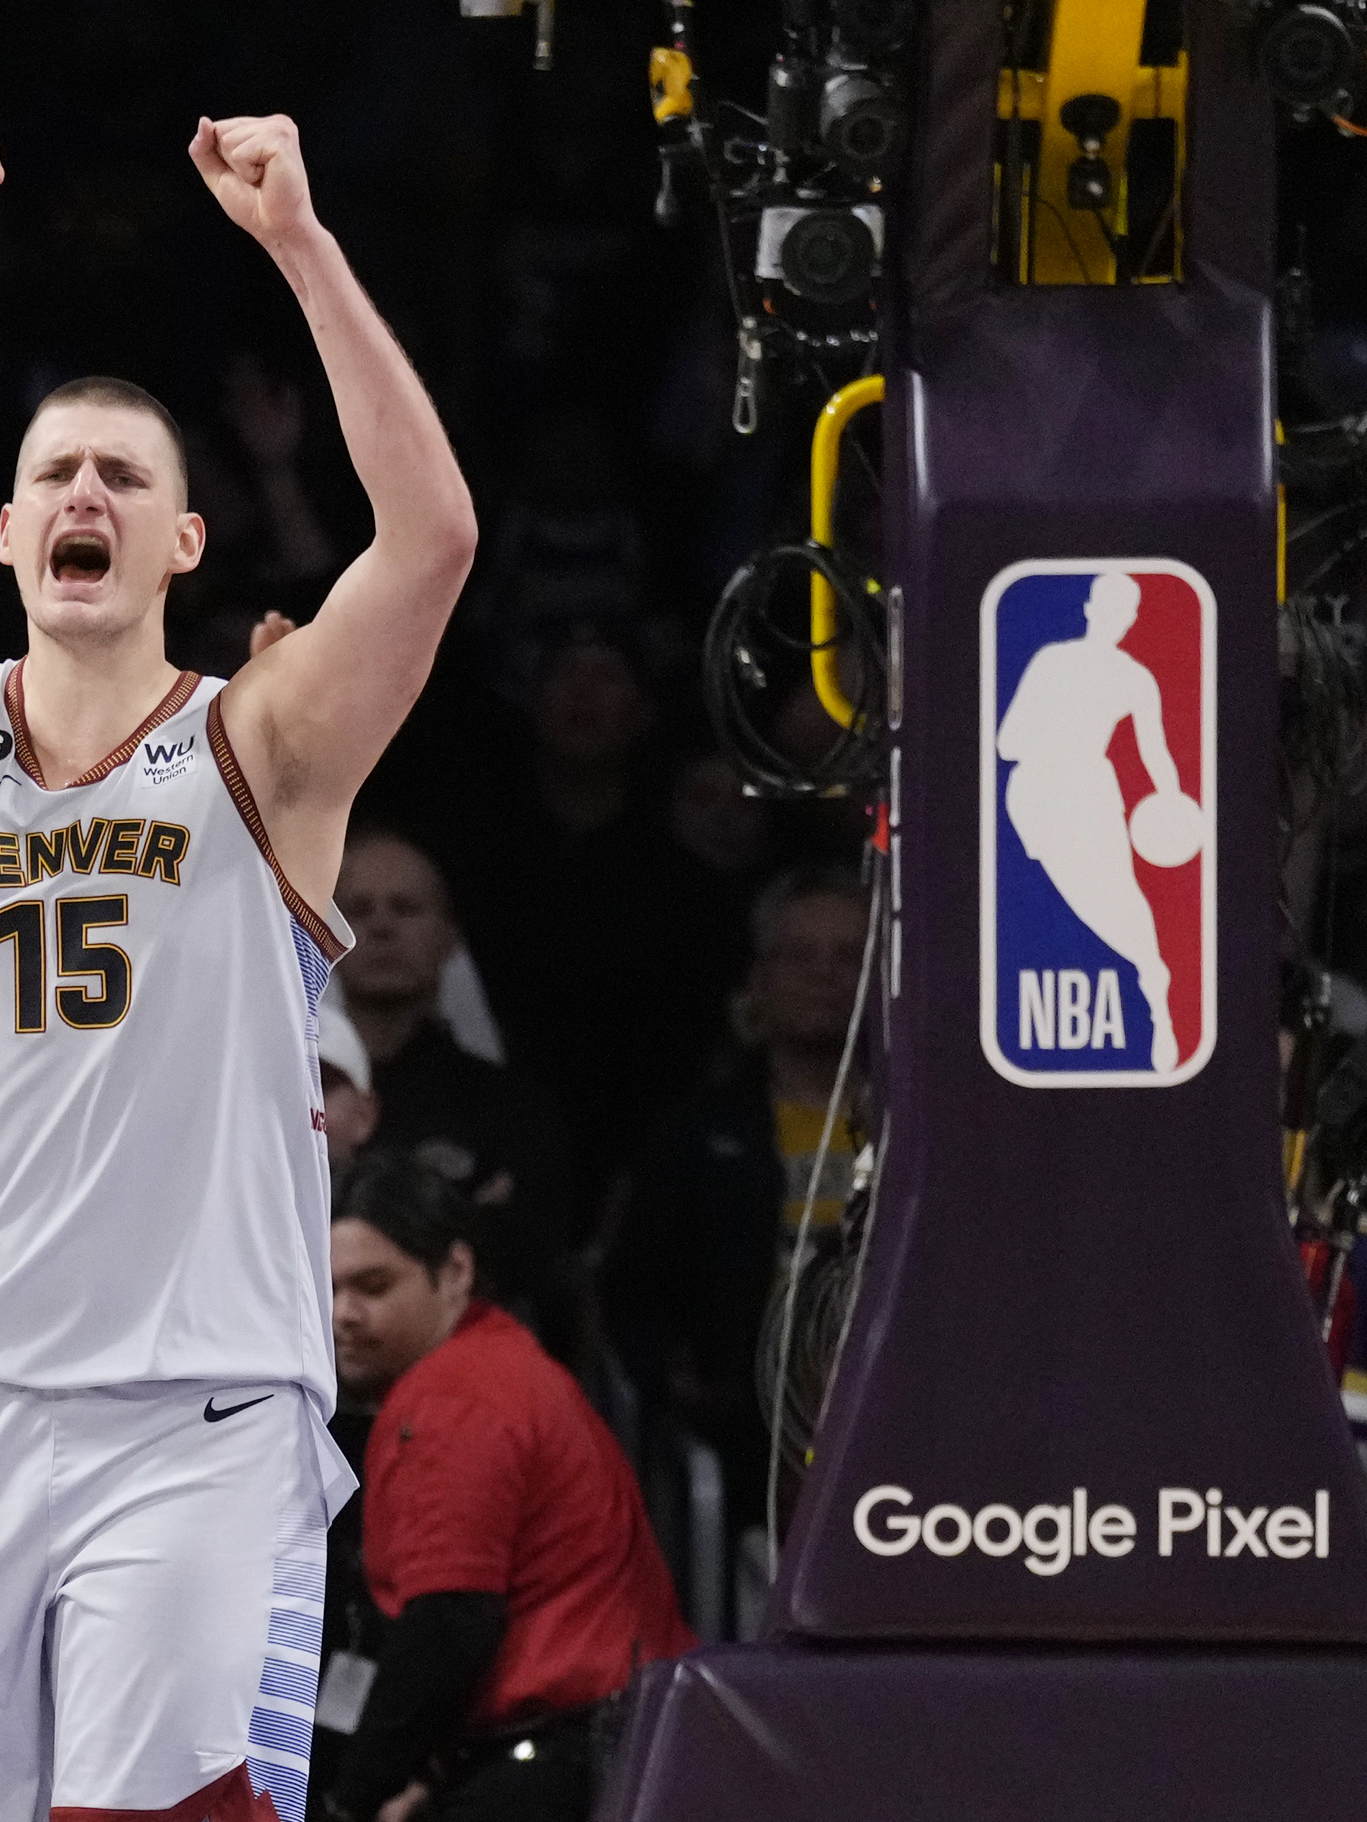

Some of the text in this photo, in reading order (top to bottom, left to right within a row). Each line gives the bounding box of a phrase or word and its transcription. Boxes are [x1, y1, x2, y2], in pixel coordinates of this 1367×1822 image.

[143, 754, 194, 776] Western
[144, 734, 195, 765] WU
[153, 766, 187, 785] Union
[1019, 968, 1126, 1050] NBA
[853, 1484, 1330, 1576] Google Pixel
